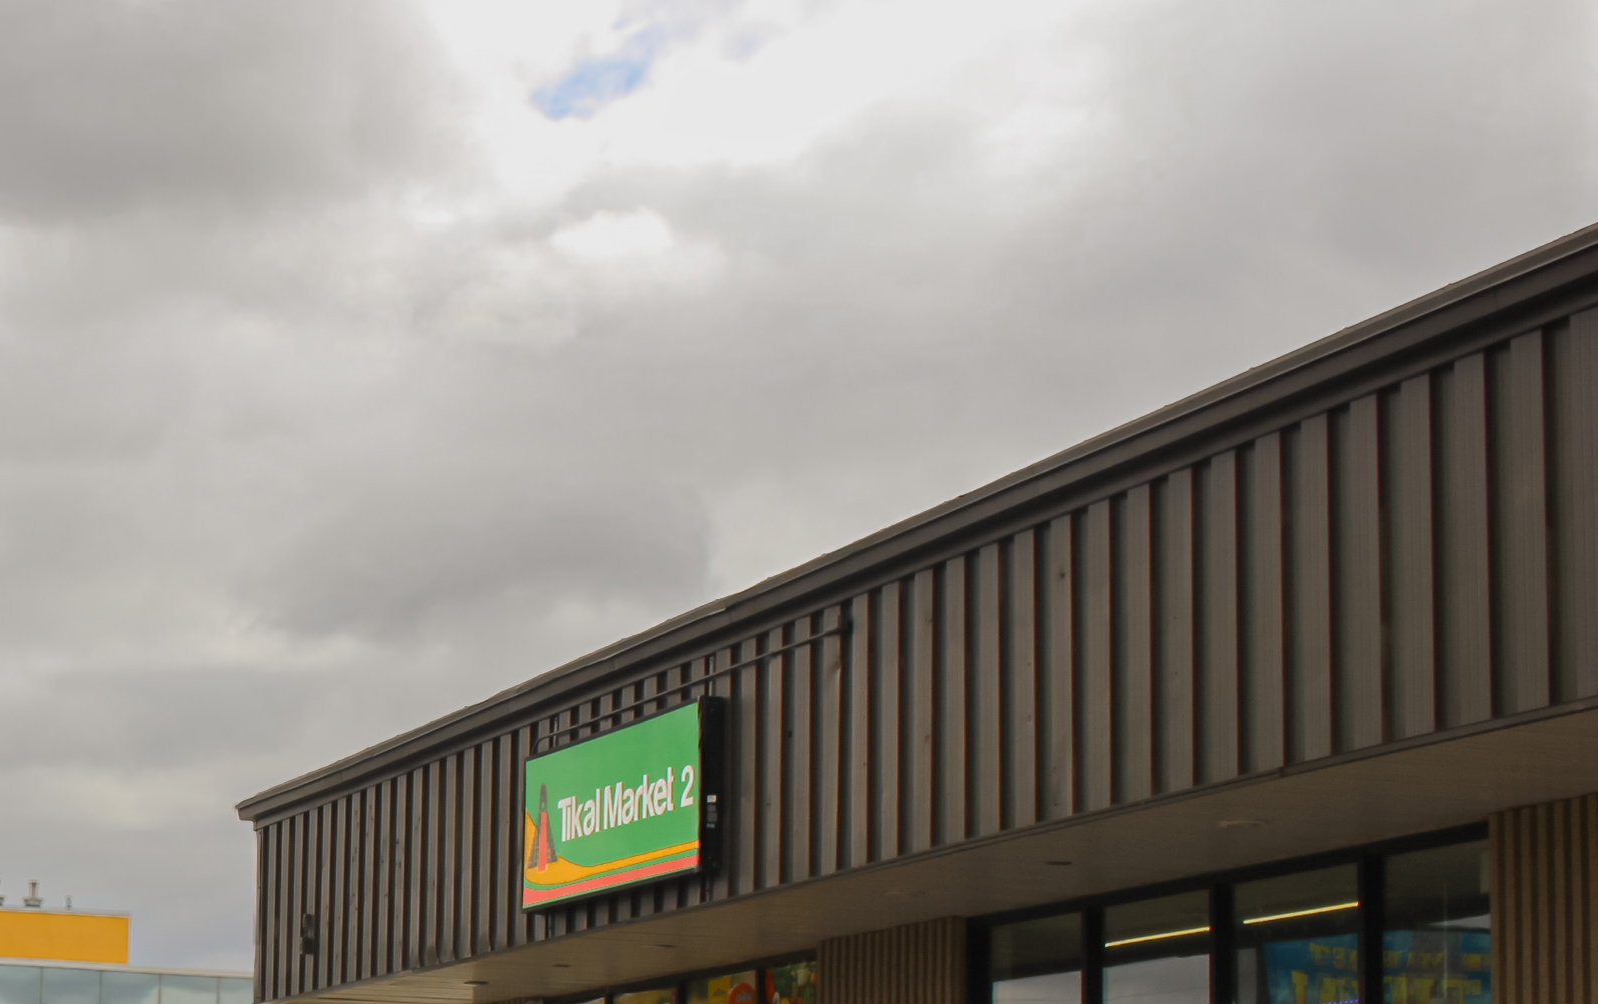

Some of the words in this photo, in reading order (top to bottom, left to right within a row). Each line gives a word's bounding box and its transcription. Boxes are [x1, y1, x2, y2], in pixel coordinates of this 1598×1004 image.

[557, 787, 601, 843] Tikal
[603, 766, 675, 832] Market
[680, 764, 696, 808] 2
